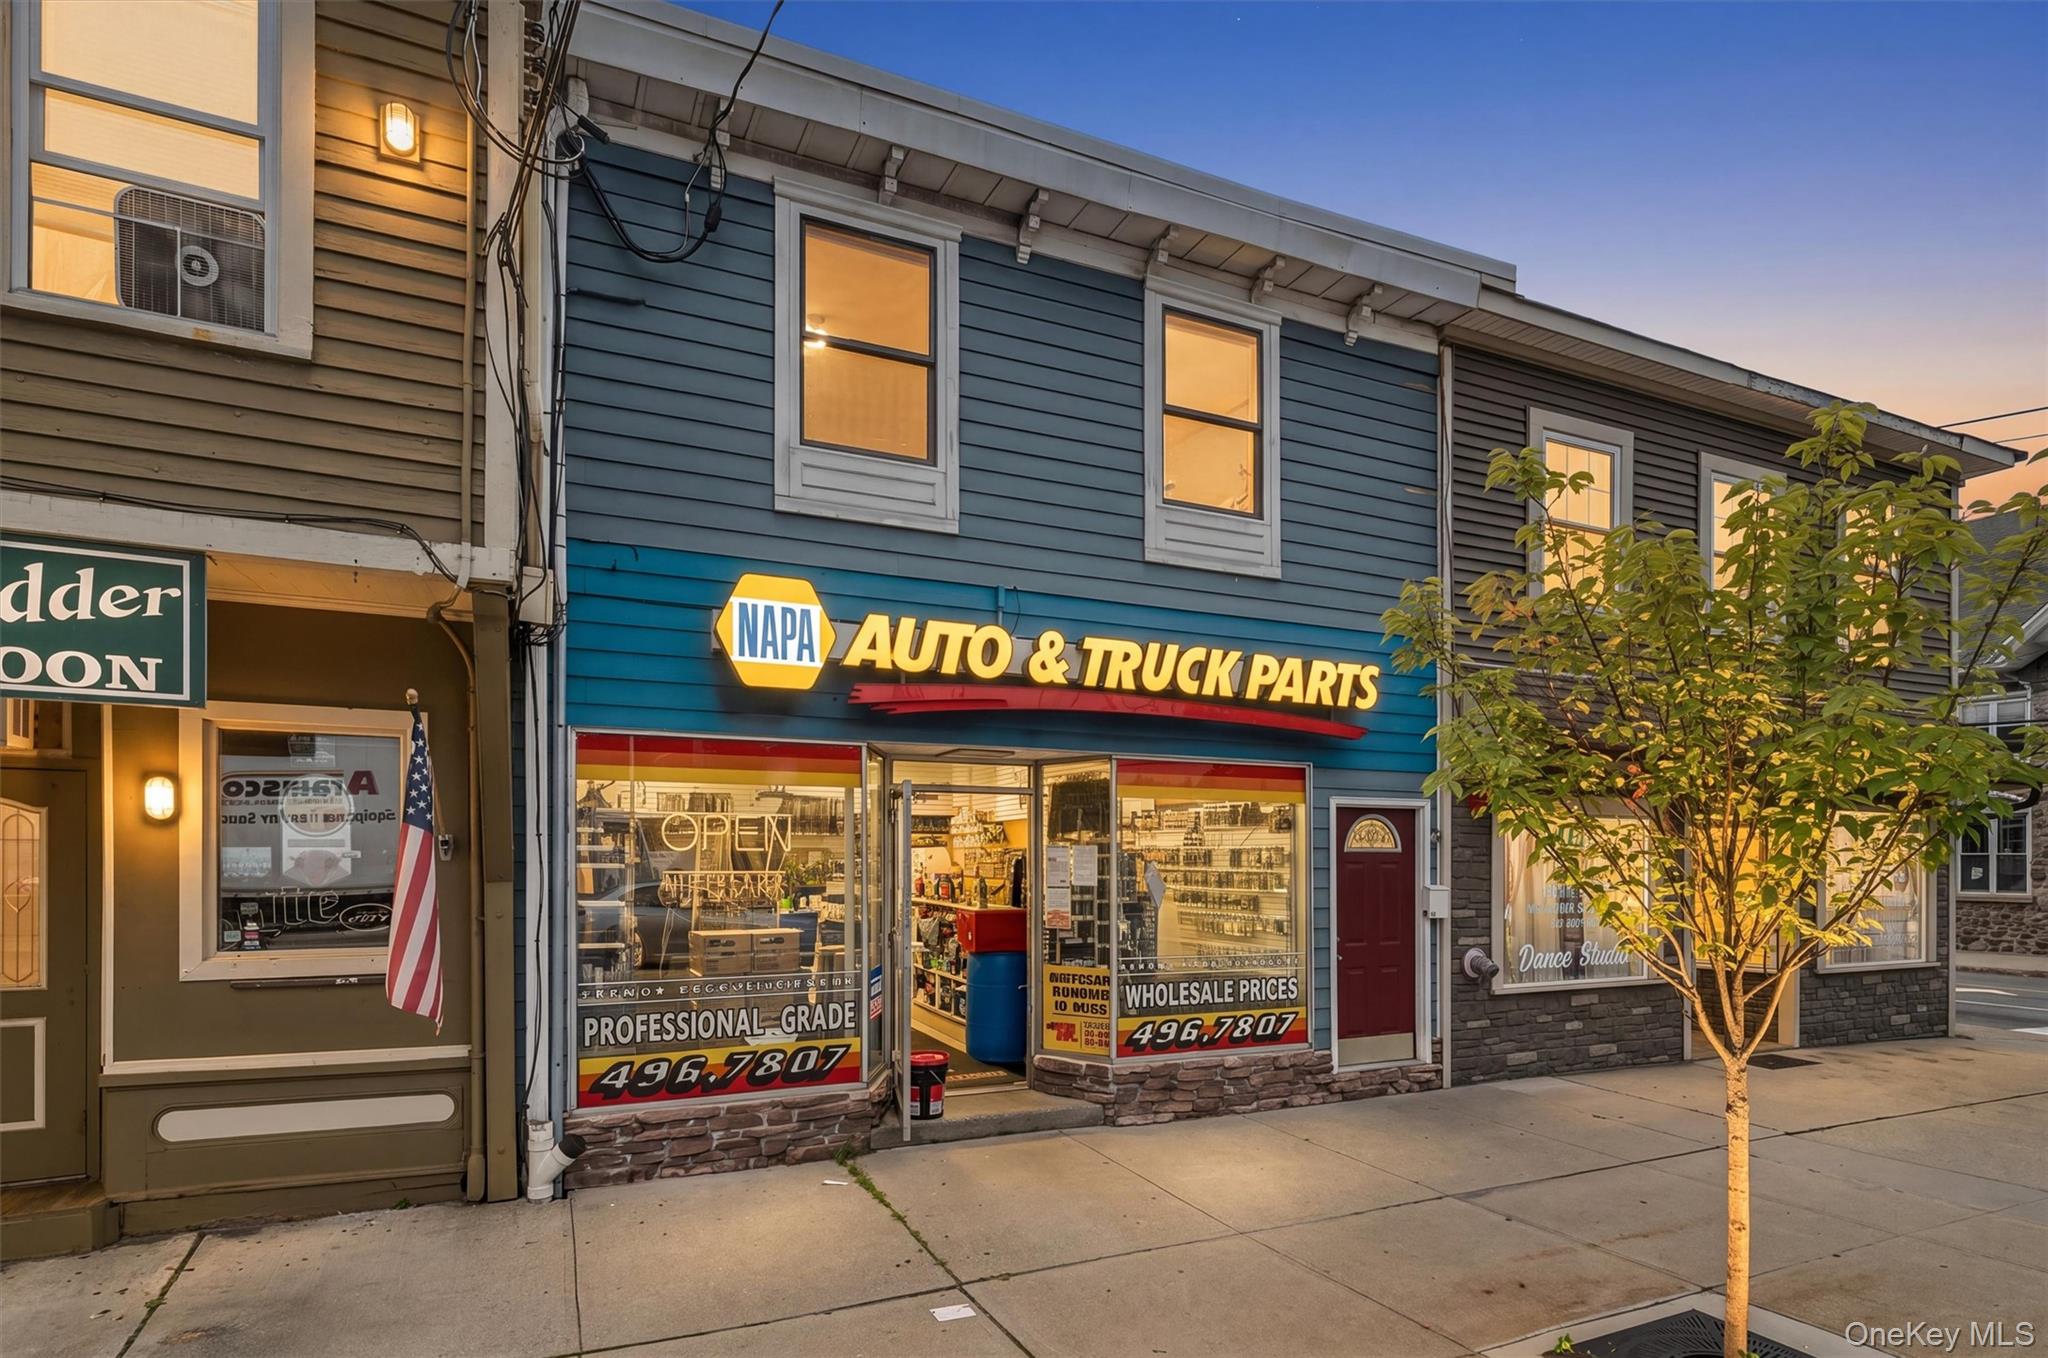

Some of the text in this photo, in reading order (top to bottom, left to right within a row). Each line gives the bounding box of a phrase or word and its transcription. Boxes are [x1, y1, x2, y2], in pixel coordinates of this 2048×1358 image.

[0, 562, 182, 623] dder
[738, 602, 816, 663] NAPA
[0, 646, 163, 692] OON
[843, 613, 1380, 711] AUTO & TRUCK PARTS
[661, 813, 791, 852] OPEN
[1519, 938, 1630, 972] Dance Studio
[1126, 977, 1298, 1008] WHOLESALE PRICES
[584, 1002, 856, 1047] PROFESSIONAL GRADE
